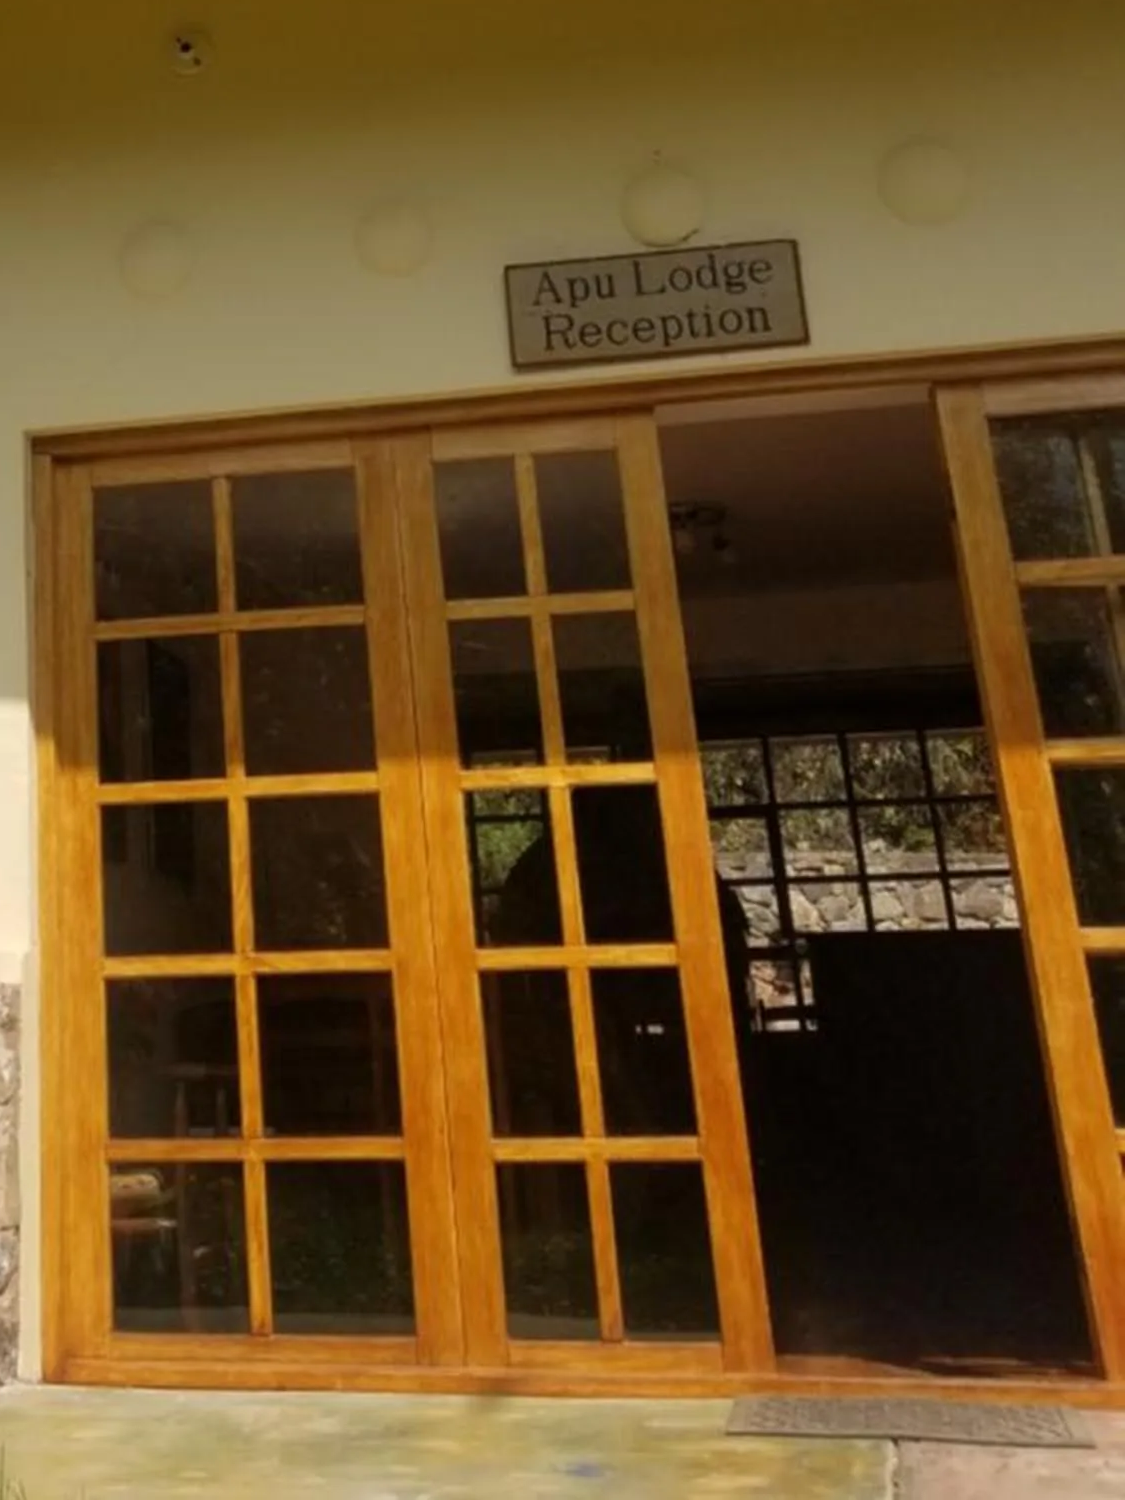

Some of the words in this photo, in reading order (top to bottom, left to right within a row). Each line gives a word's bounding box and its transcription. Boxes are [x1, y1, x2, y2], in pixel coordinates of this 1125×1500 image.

[532, 271, 616, 308] Apu
[632, 253, 773, 296] Lodge
[543, 305, 772, 350] Reception
